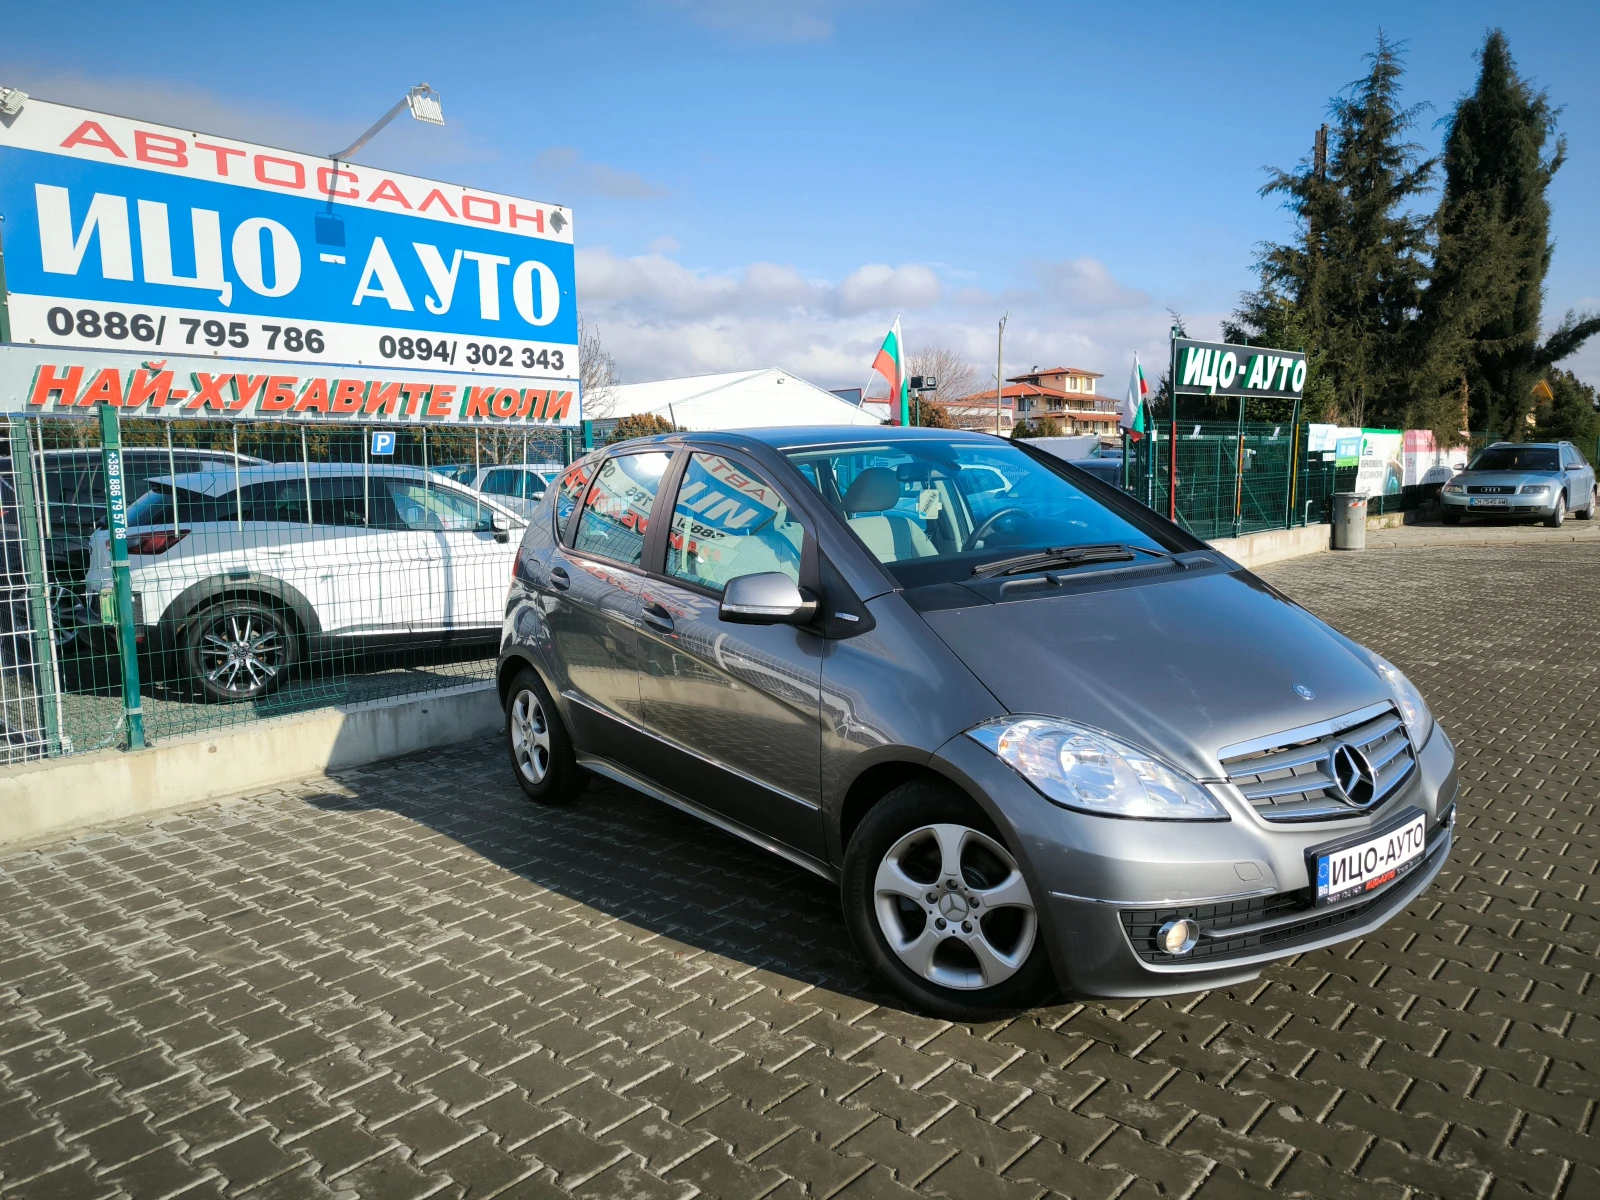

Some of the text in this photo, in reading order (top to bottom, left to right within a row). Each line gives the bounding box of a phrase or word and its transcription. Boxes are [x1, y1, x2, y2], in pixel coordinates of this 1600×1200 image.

[59, 120, 544, 233] АВТОСАЛОН
[46, 306, 564, 371] 0886/ 795 786 0894/ 302 343
[29, 359, 573, 419] НАЙ-ХУБАВИТЕ КОЛИ
[1183, 346, 1307, 394] ИЦО-АУТО
[376, 434, 391, 452] P
[108, 452, 127, 540] +359 886 79 57 86
[1332, 823, 1424, 887] ИЦО-АУТО
[1318, 884, 1328, 897] BG
